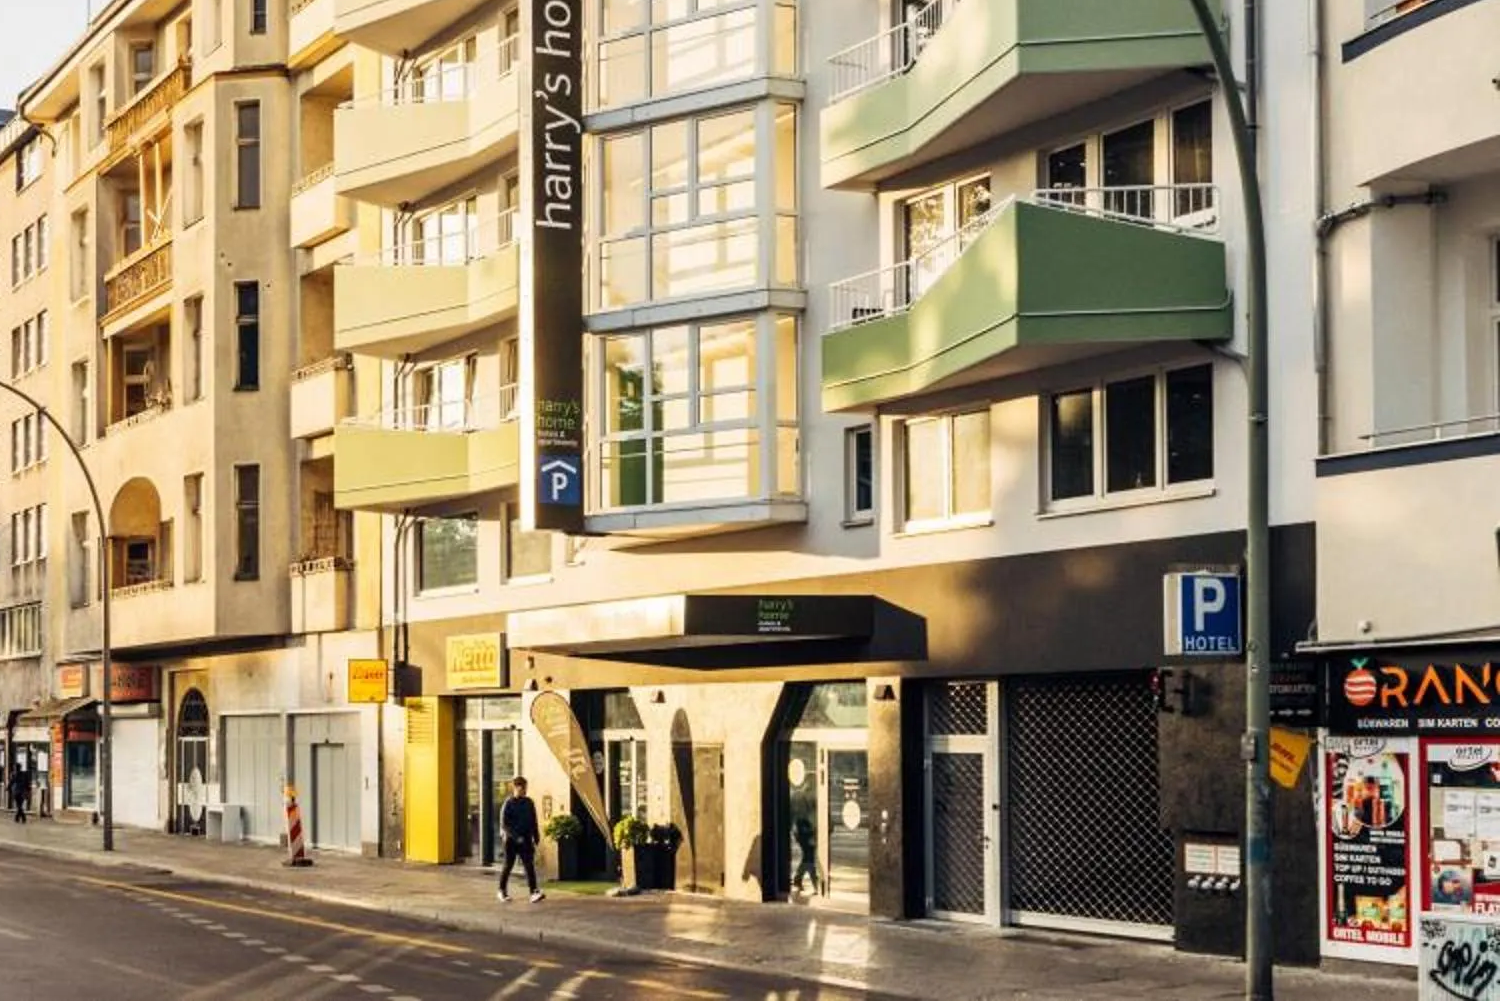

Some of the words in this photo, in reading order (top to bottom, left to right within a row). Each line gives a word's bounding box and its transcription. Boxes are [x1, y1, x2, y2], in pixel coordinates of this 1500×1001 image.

[535, 73, 581, 229] harry's
[552, 472, 568, 500] P
[1194, 578, 1226, 632] P
[452, 639, 497, 673] Netto
[1185, 635, 1237, 651] HOTEL
[1343, 661, 1500, 708] ORAN
[1417, 718, 1435, 728] SIM
[1437, 717, 1479, 728] KARTEN
[1334, 863, 1350, 872] TOP
[1351, 864, 1362, 873] UP
[1366, 876, 1376, 885] TO
[1379, 877, 1392, 886] GO
